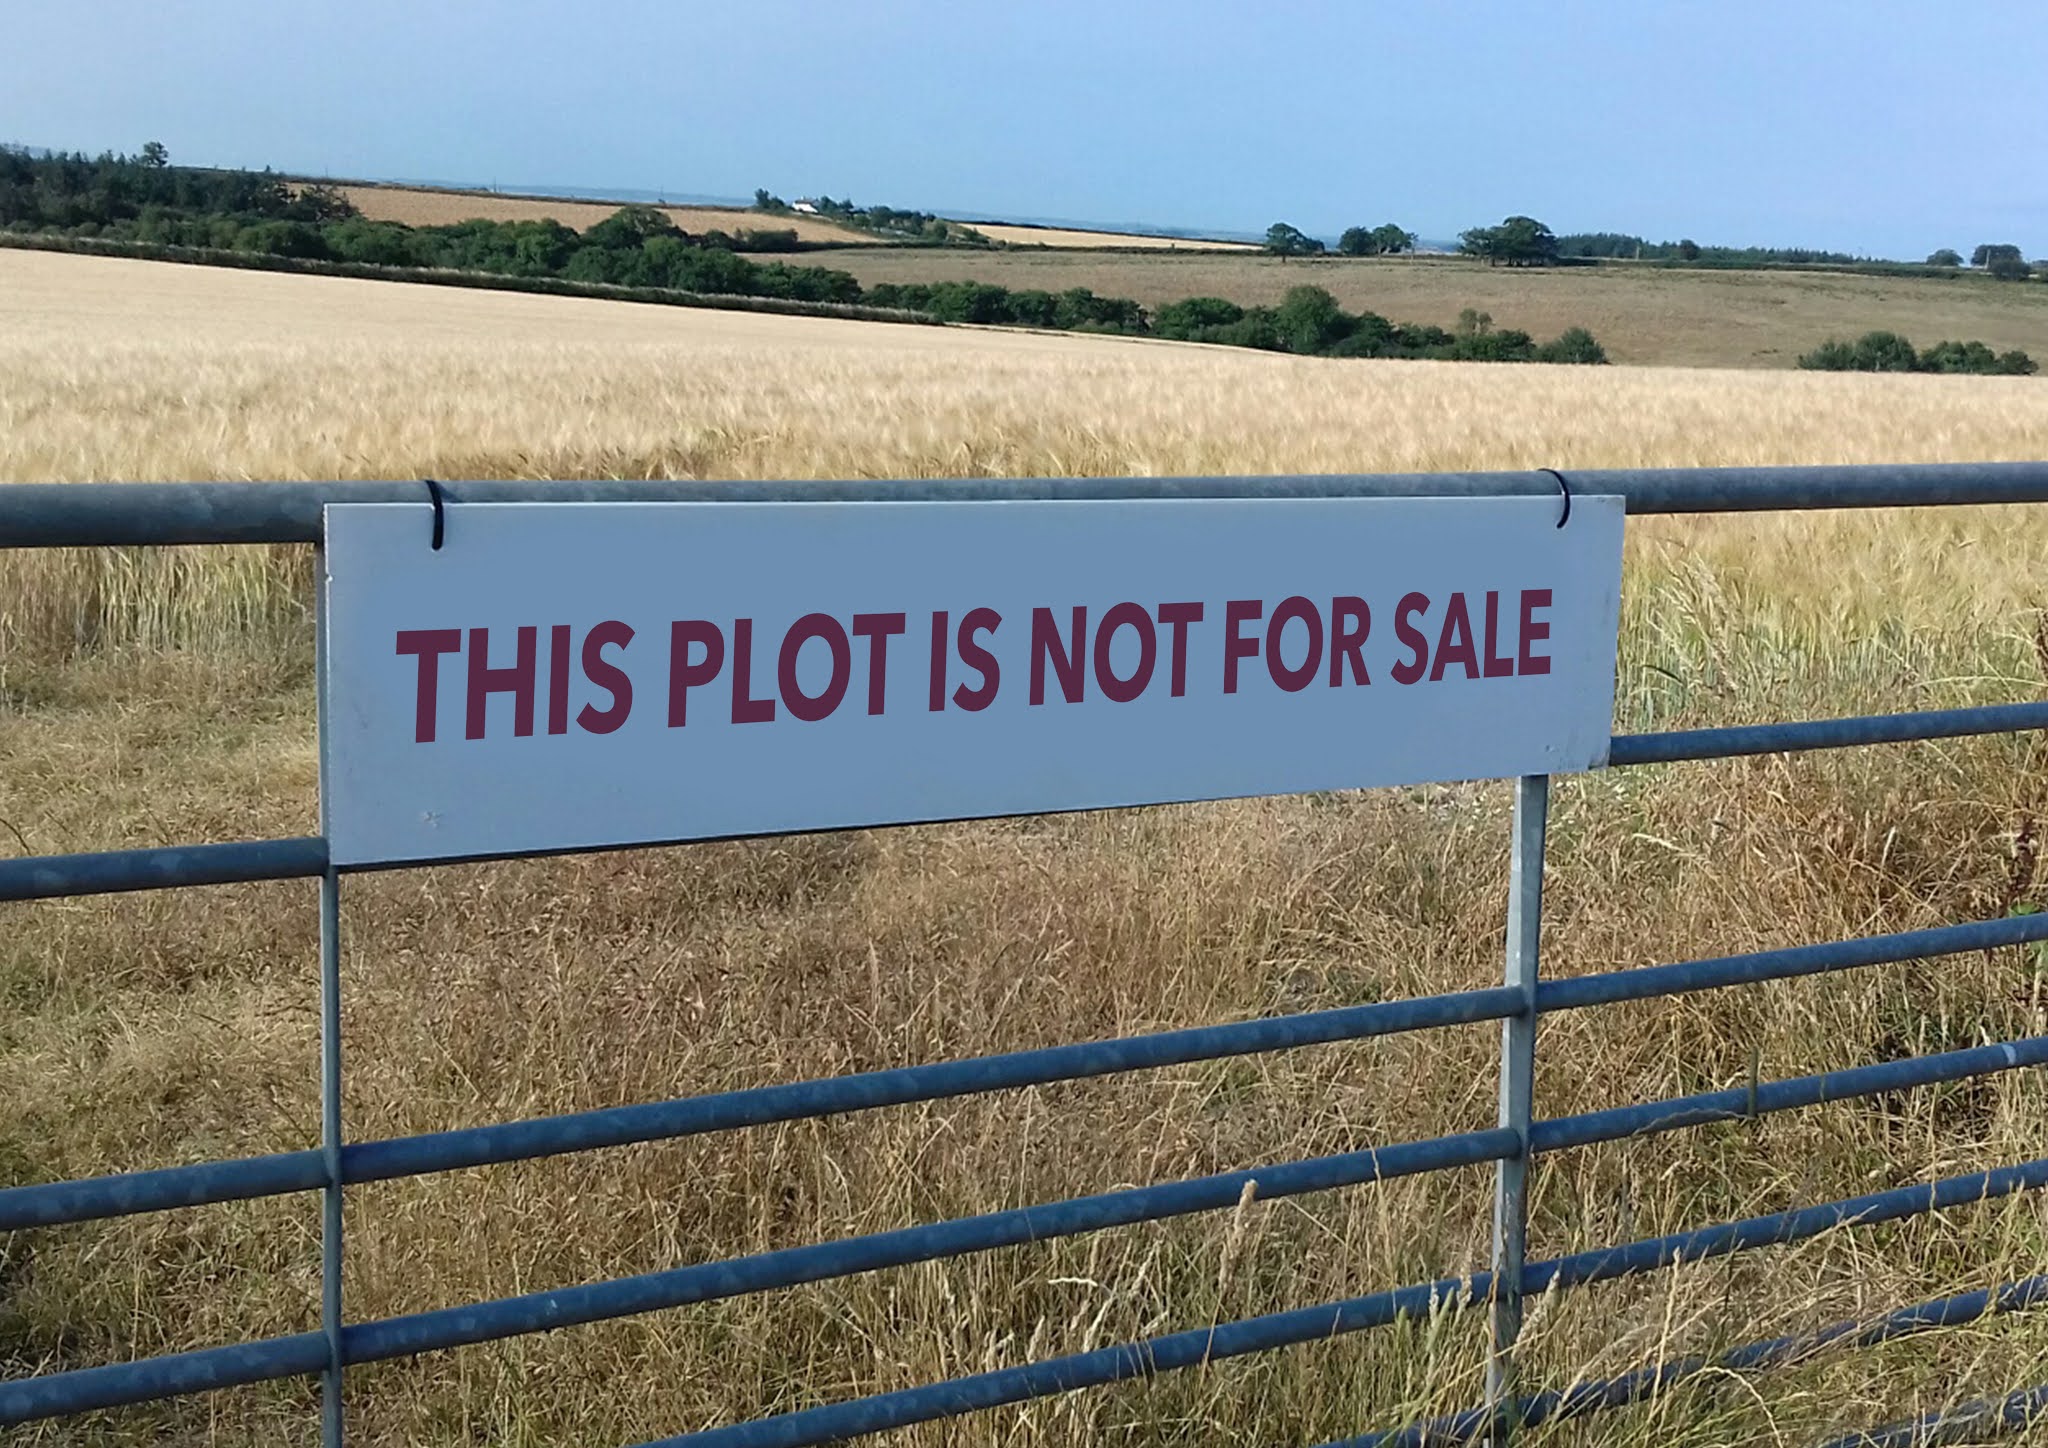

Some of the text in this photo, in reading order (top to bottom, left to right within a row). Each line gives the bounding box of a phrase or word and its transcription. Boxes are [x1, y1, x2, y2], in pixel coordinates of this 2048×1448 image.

[396, 588, 1553, 743] THIS PLOT IS NOT FOR SALE
